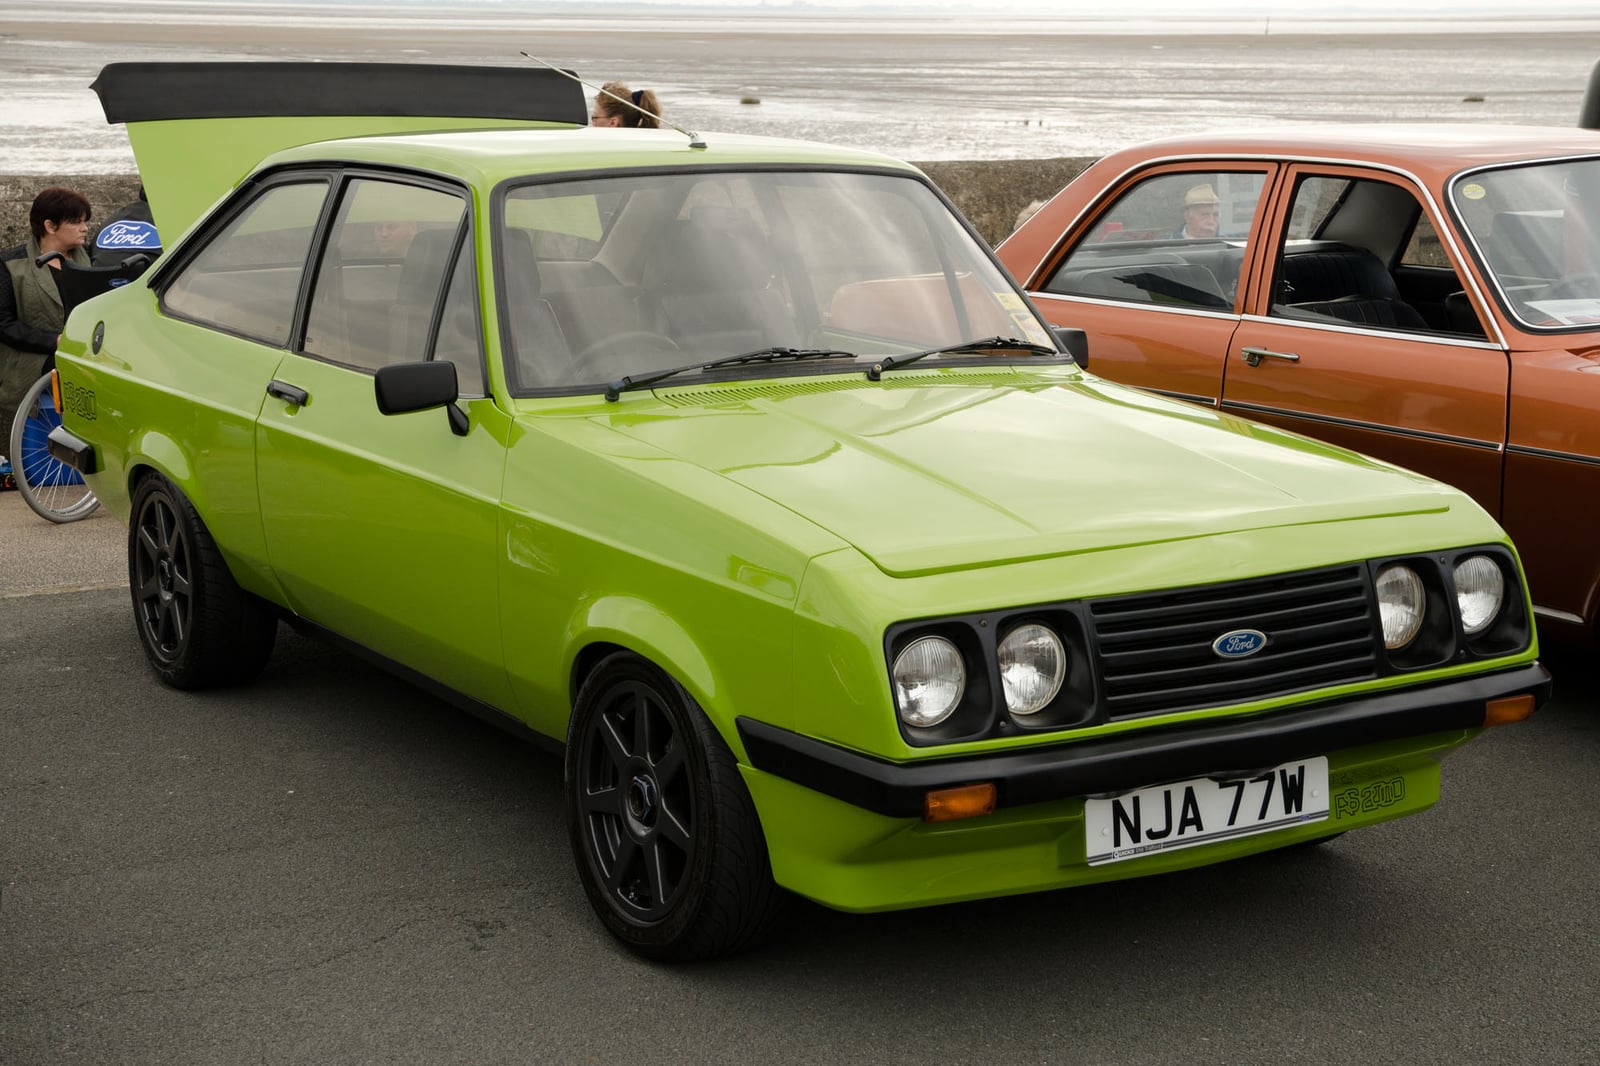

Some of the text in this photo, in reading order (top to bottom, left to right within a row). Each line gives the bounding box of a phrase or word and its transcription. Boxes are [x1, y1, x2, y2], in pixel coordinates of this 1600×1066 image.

[102, 223, 151, 245] Ford
[1226, 634, 1255, 652] Ford
[1112, 765, 1305, 848] NJA 77W
